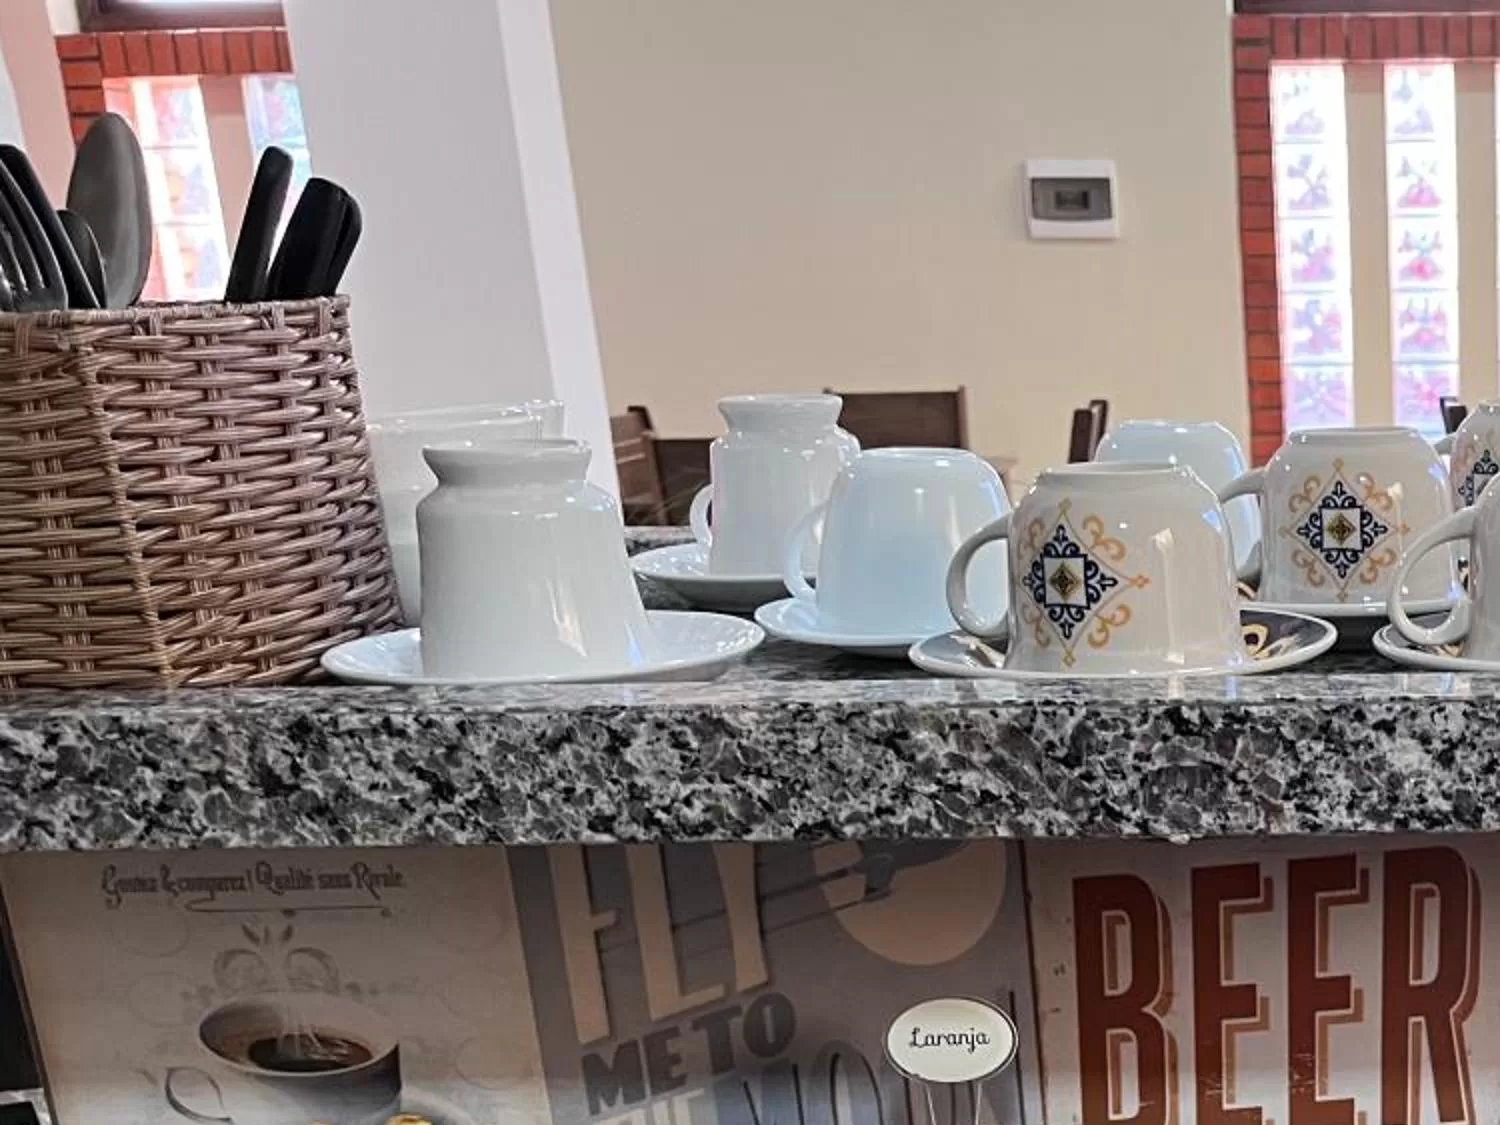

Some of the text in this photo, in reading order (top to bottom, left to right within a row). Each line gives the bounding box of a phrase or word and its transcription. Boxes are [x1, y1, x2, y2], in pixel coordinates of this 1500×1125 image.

[581, 992, 797, 1116] ME TO
[909, 1027, 991, 1055] Laranja
